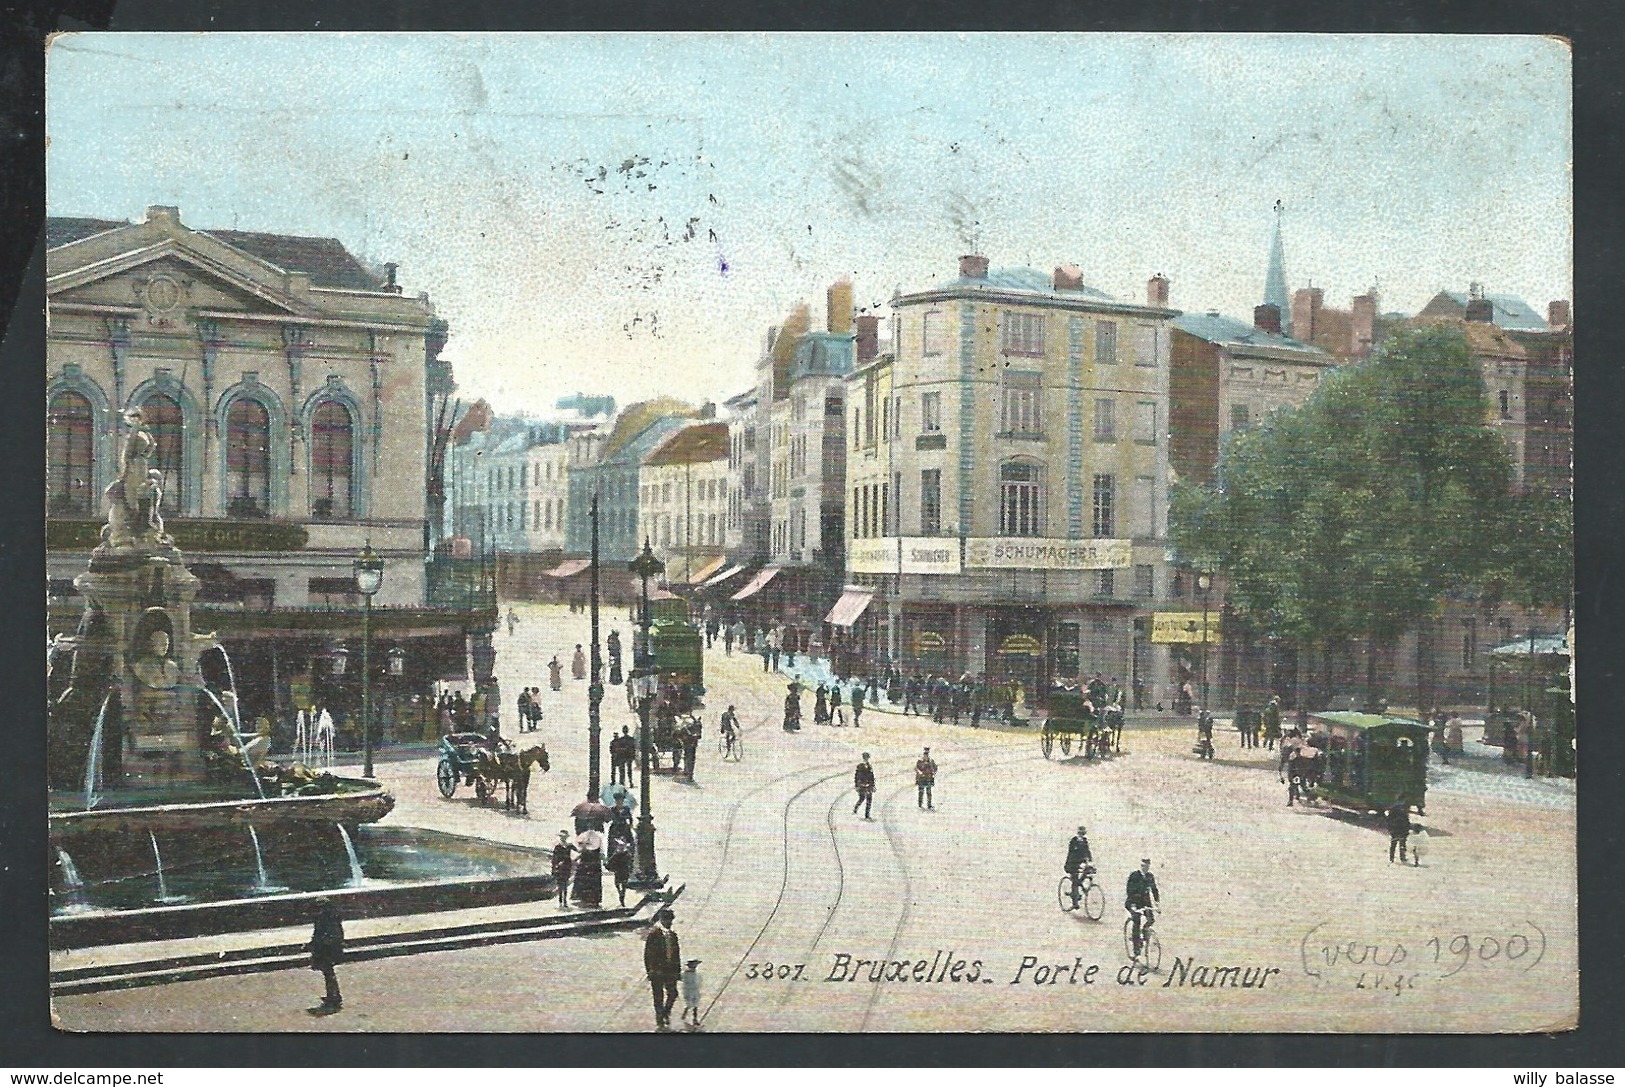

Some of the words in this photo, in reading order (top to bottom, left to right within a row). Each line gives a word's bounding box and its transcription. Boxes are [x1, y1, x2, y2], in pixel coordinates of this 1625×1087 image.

[994, 545, 1097, 559] SCHUMACHER
[1011, 956, 1096, 985] Porte
[1116, 956, 1150, 985] de
[1164, 957, 1280, 988] Namur
